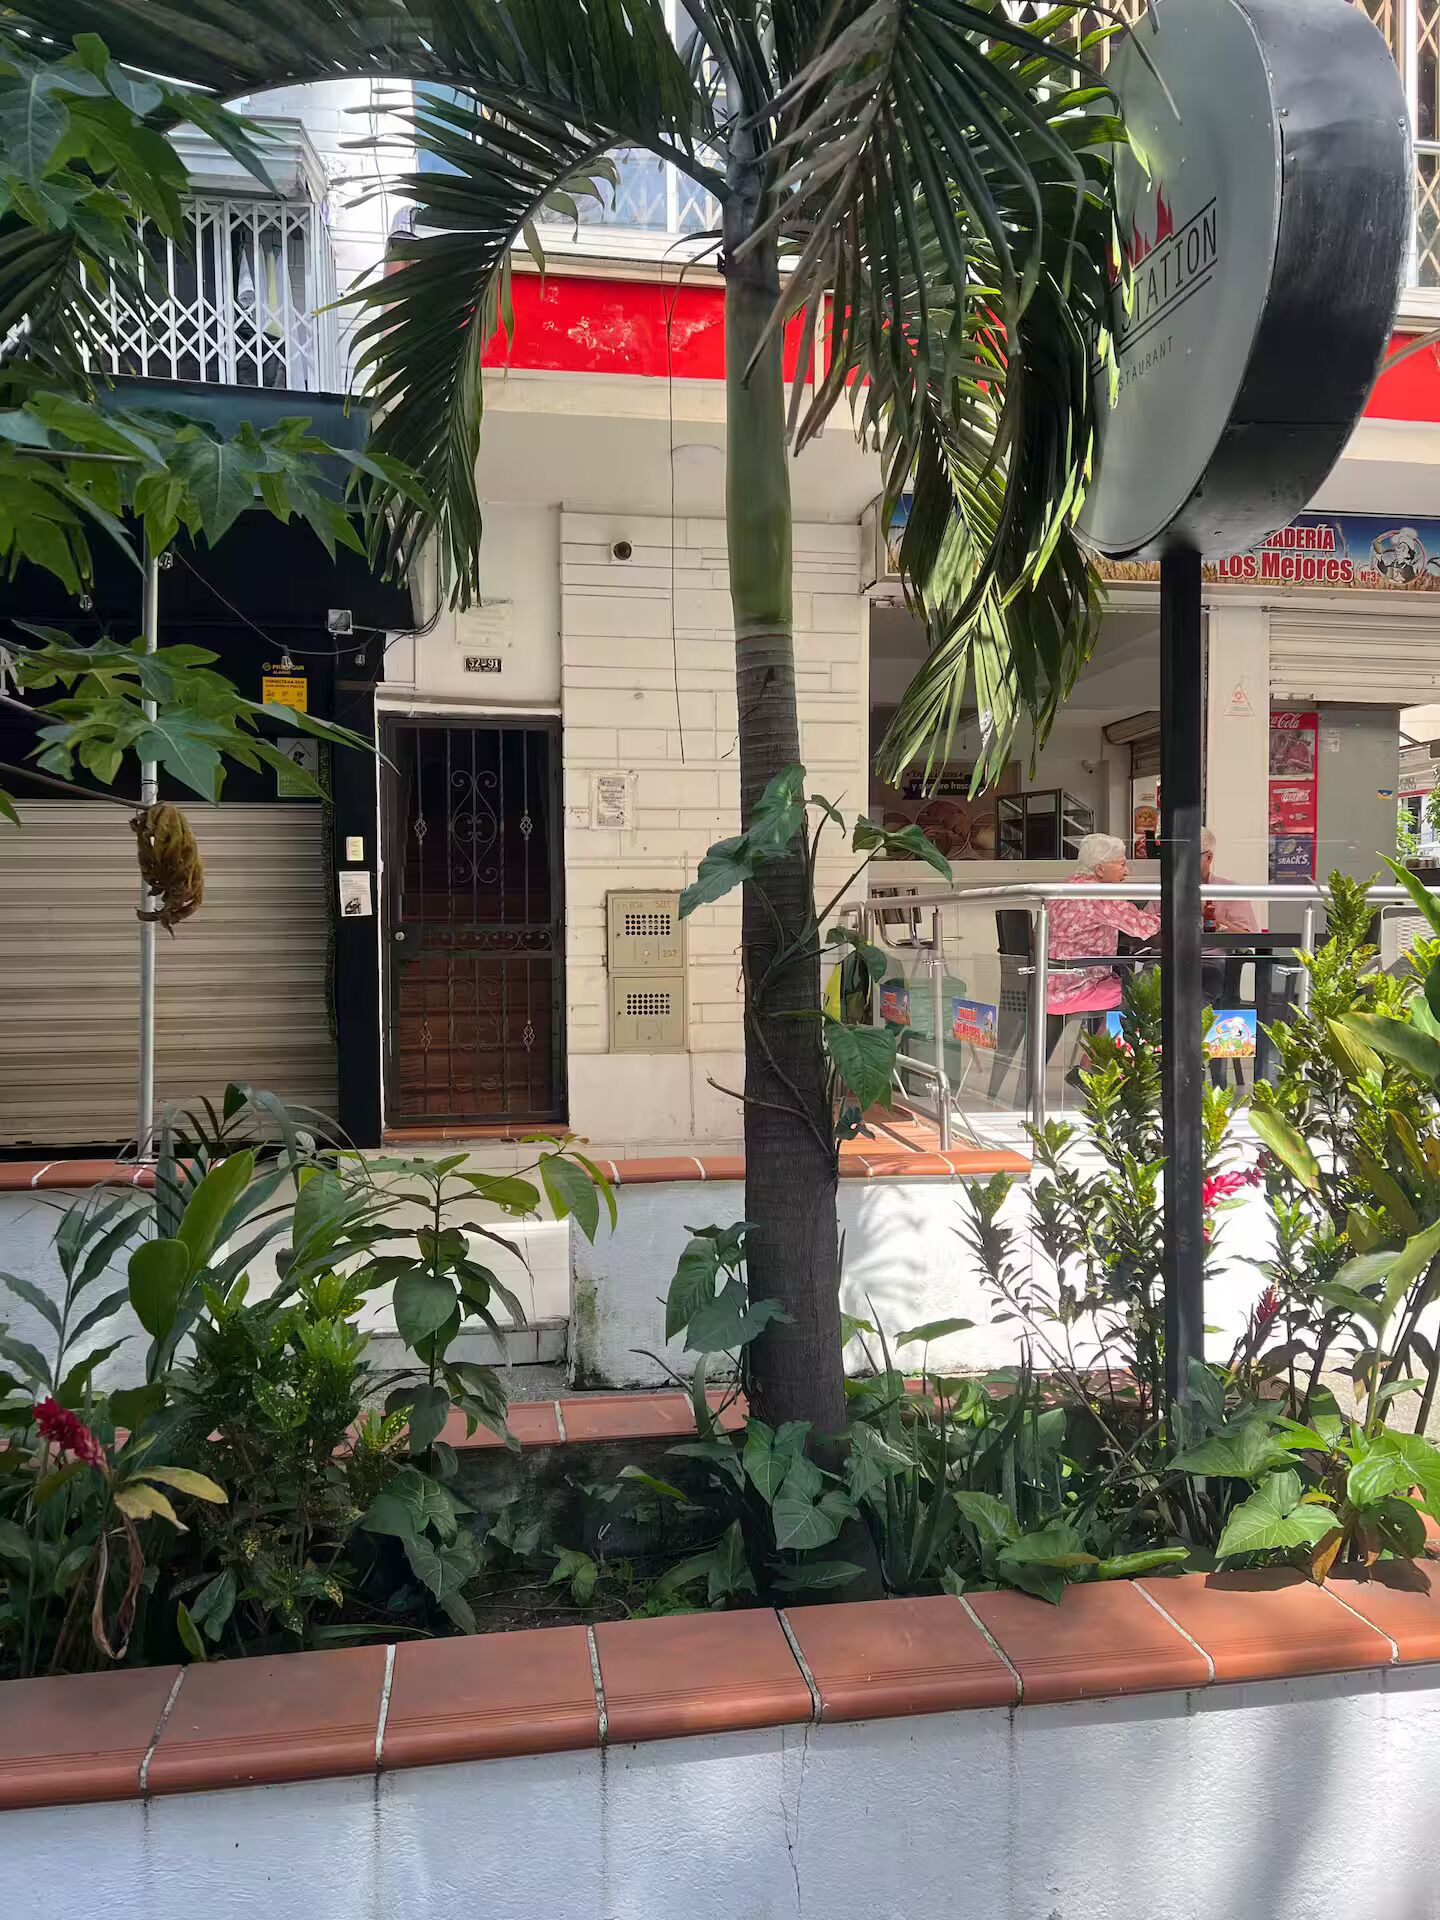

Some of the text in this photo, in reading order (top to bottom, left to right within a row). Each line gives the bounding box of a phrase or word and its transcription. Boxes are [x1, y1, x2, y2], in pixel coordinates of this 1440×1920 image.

[1118, 335, 1173, 392] STAURANT
[1262, 523, 1334, 549] ADERÍA
[1262, 552, 1353, 582] Mejores
